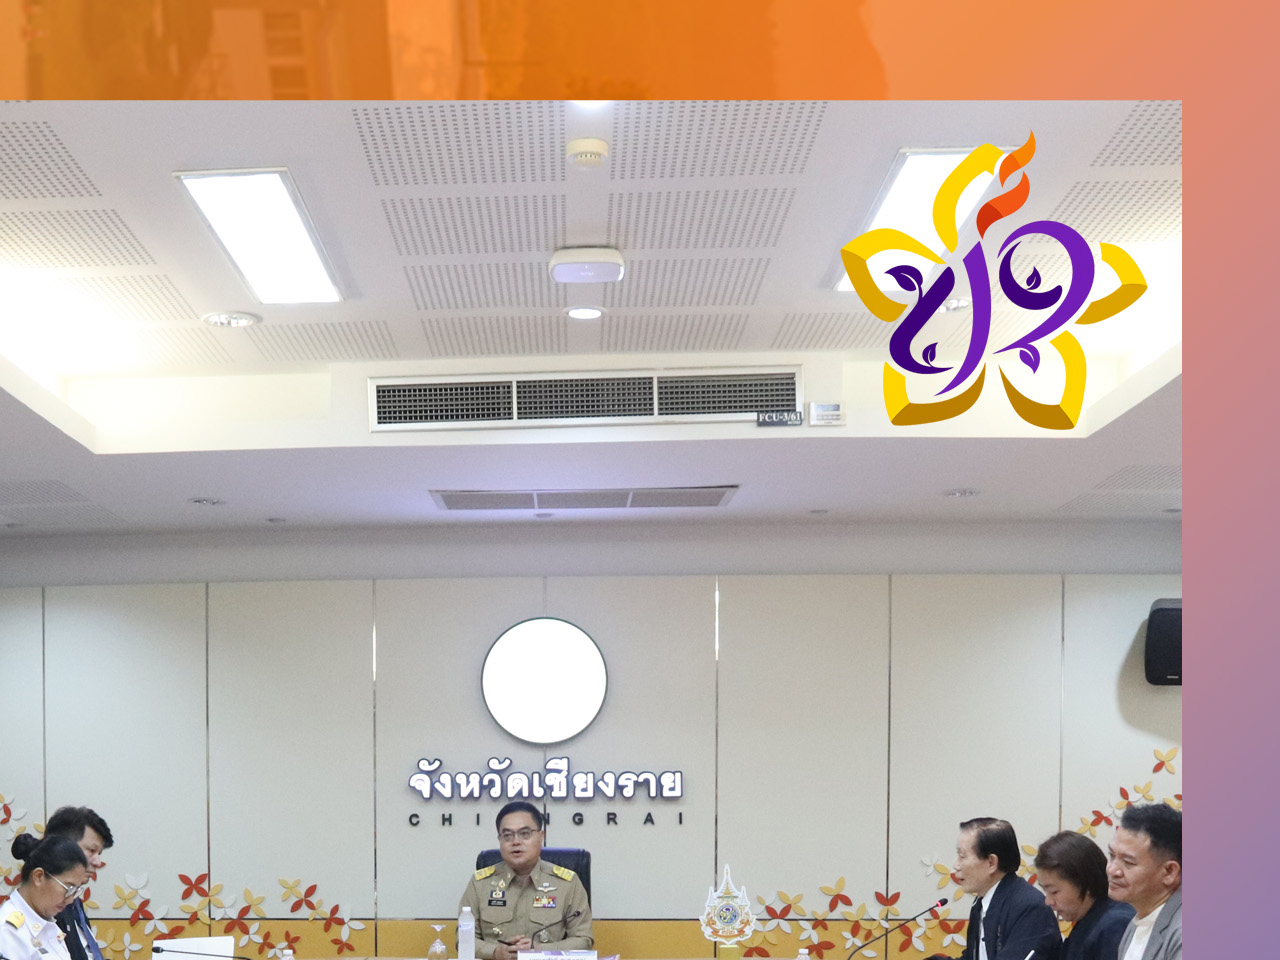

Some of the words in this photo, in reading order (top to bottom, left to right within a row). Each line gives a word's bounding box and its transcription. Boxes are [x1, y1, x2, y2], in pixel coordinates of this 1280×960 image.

[758, 412, 801, 422] FCU-3/61
[408, 756, 684, 800] จังหวัดเชียงราย
[408, 812, 683, 827] CHINGRAI
